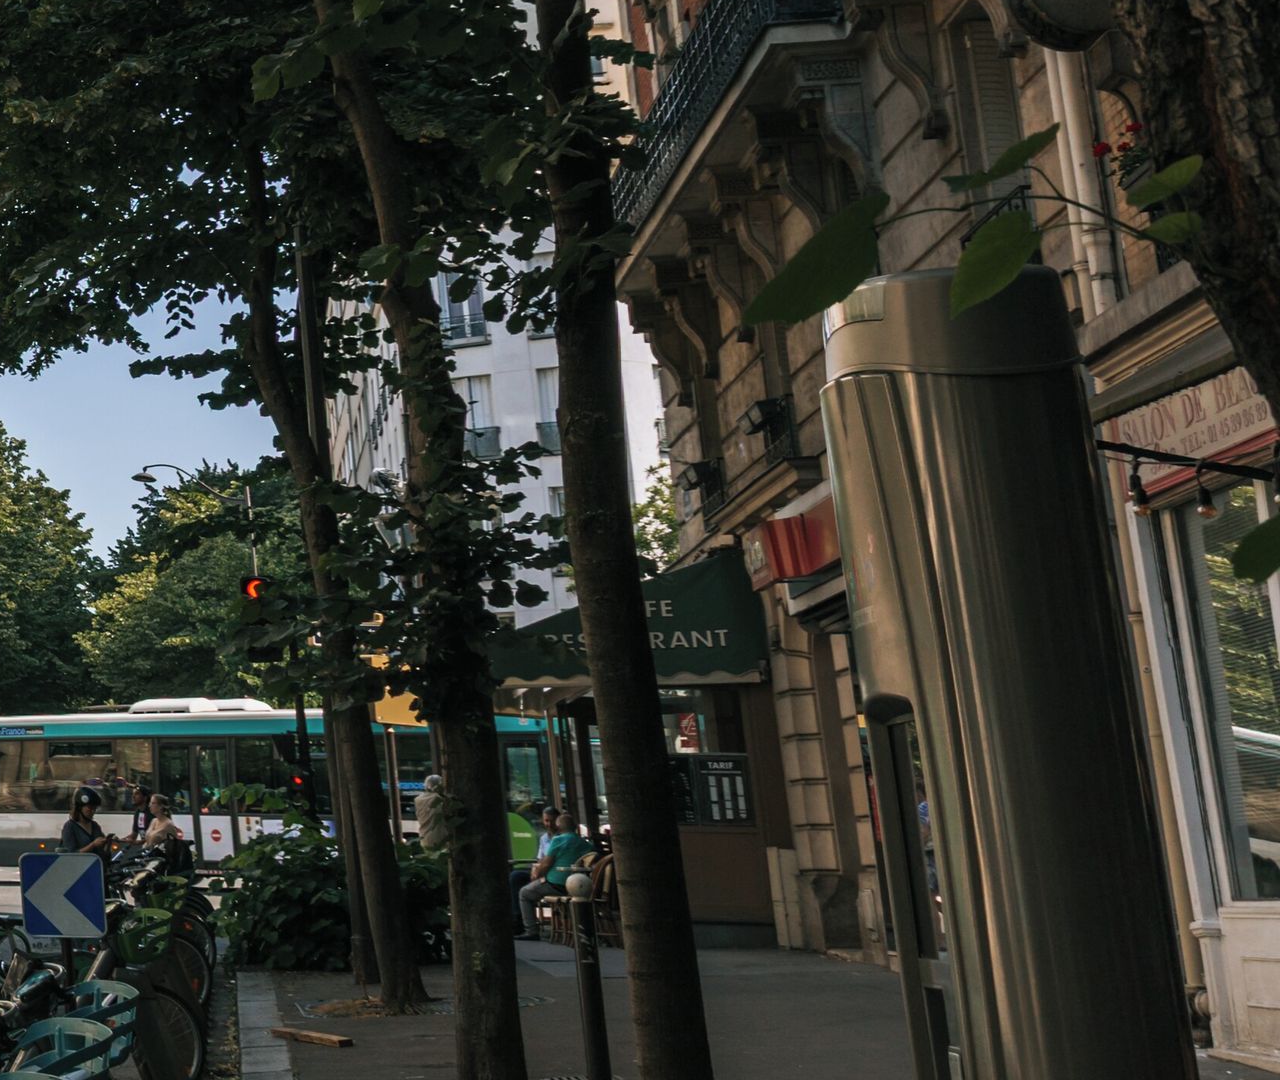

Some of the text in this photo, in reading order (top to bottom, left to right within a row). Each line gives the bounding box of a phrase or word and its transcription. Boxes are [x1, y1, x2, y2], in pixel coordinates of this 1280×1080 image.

[1122, 398, 1177, 448] SALON
[1181, 387, 1207, 428] DE
[707, 761, 735, 770] TARIF
